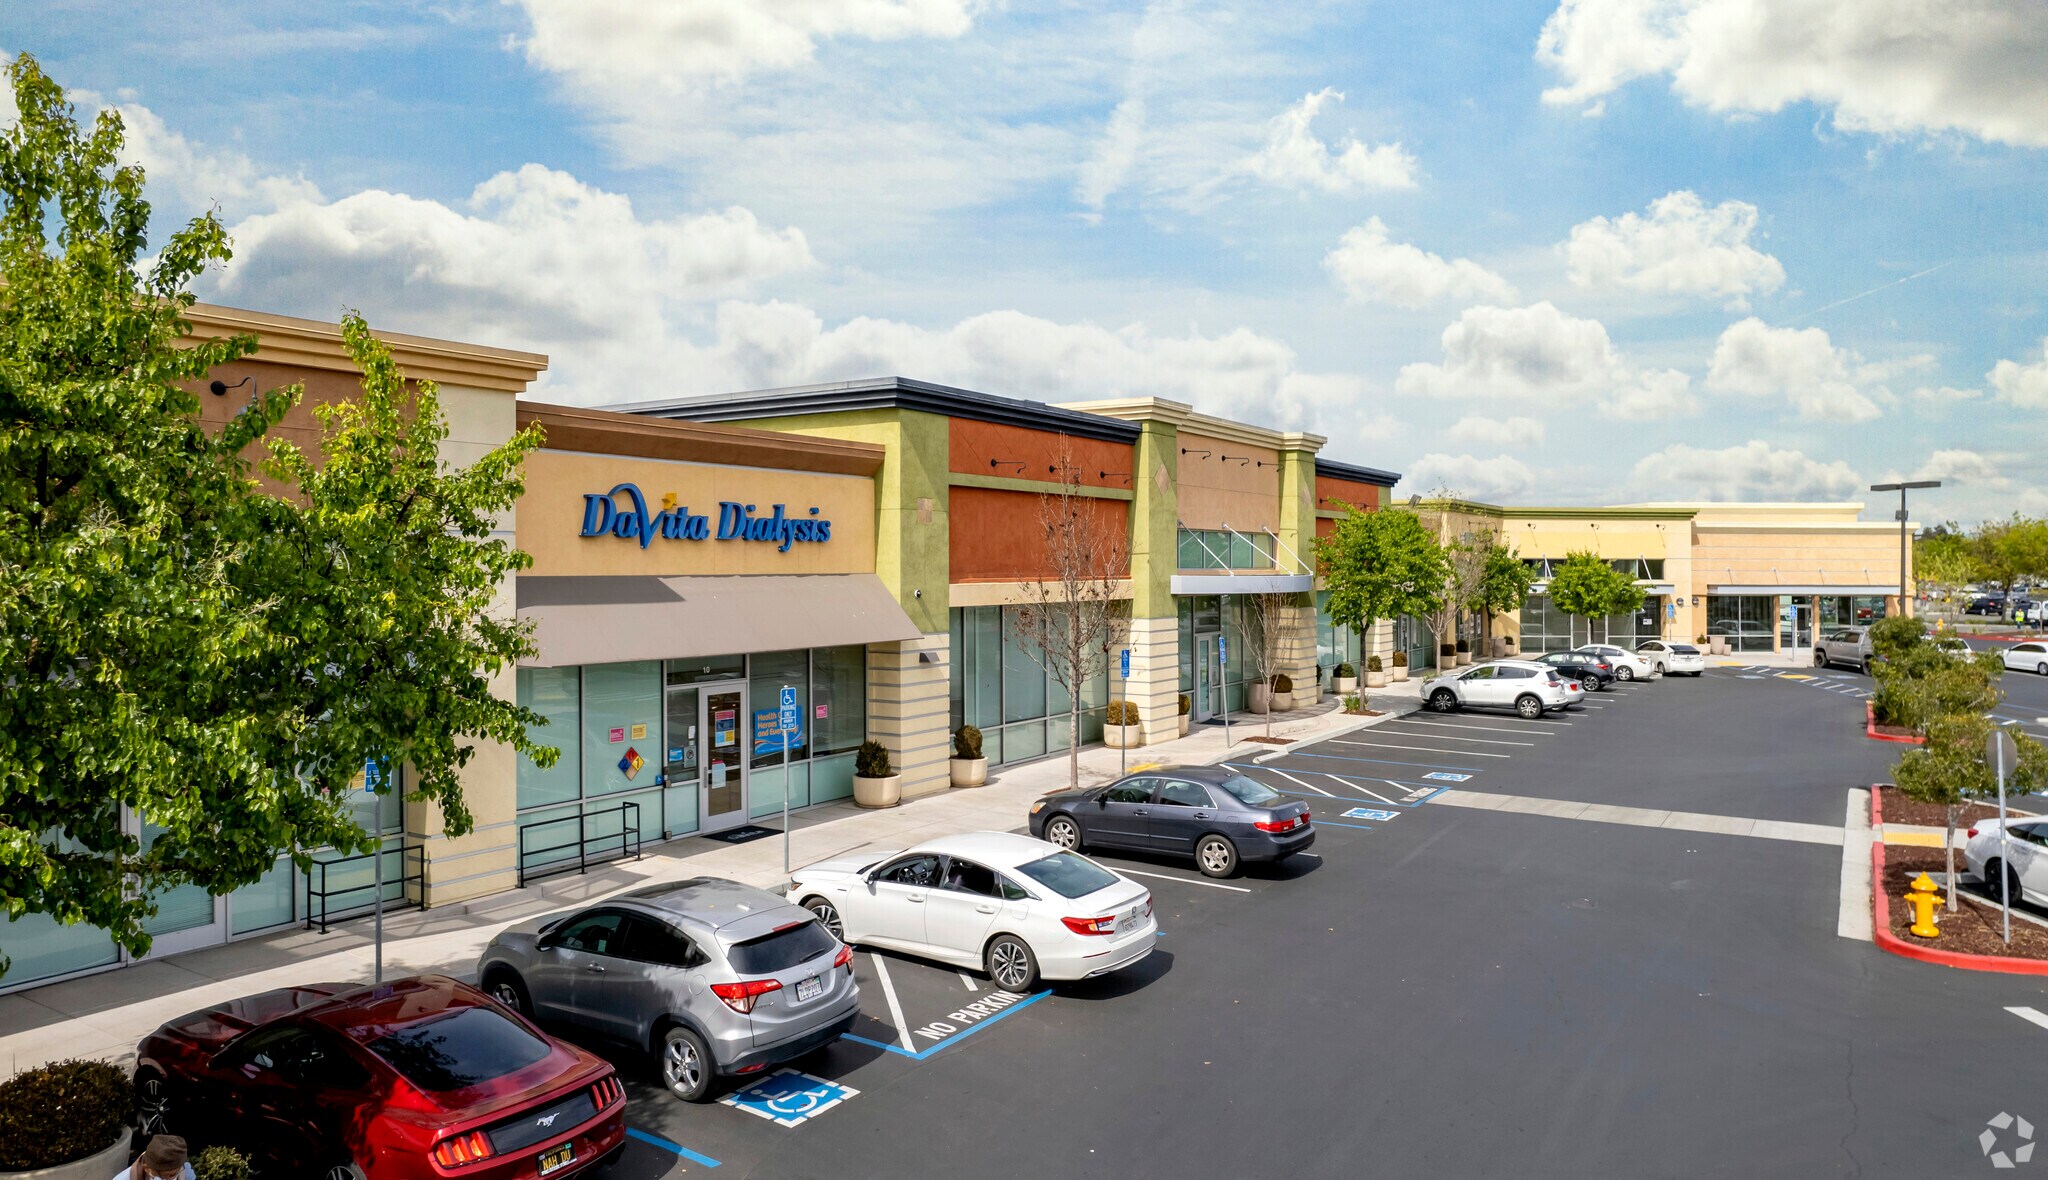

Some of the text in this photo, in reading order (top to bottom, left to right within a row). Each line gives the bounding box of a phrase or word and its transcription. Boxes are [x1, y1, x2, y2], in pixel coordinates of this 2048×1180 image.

[579, 483, 831, 552] DaVita Dialysis
[702, 666, 711, 674] 10
[758, 712, 776, 720] Health
[758, 721, 776, 729] Heroes
[628, 750, 635, 760] 0
[622, 757, 640, 770] 2 1
[913, 990, 1028, 1040] NO PARKIN
[542, 1154, 558, 1171] NAH
